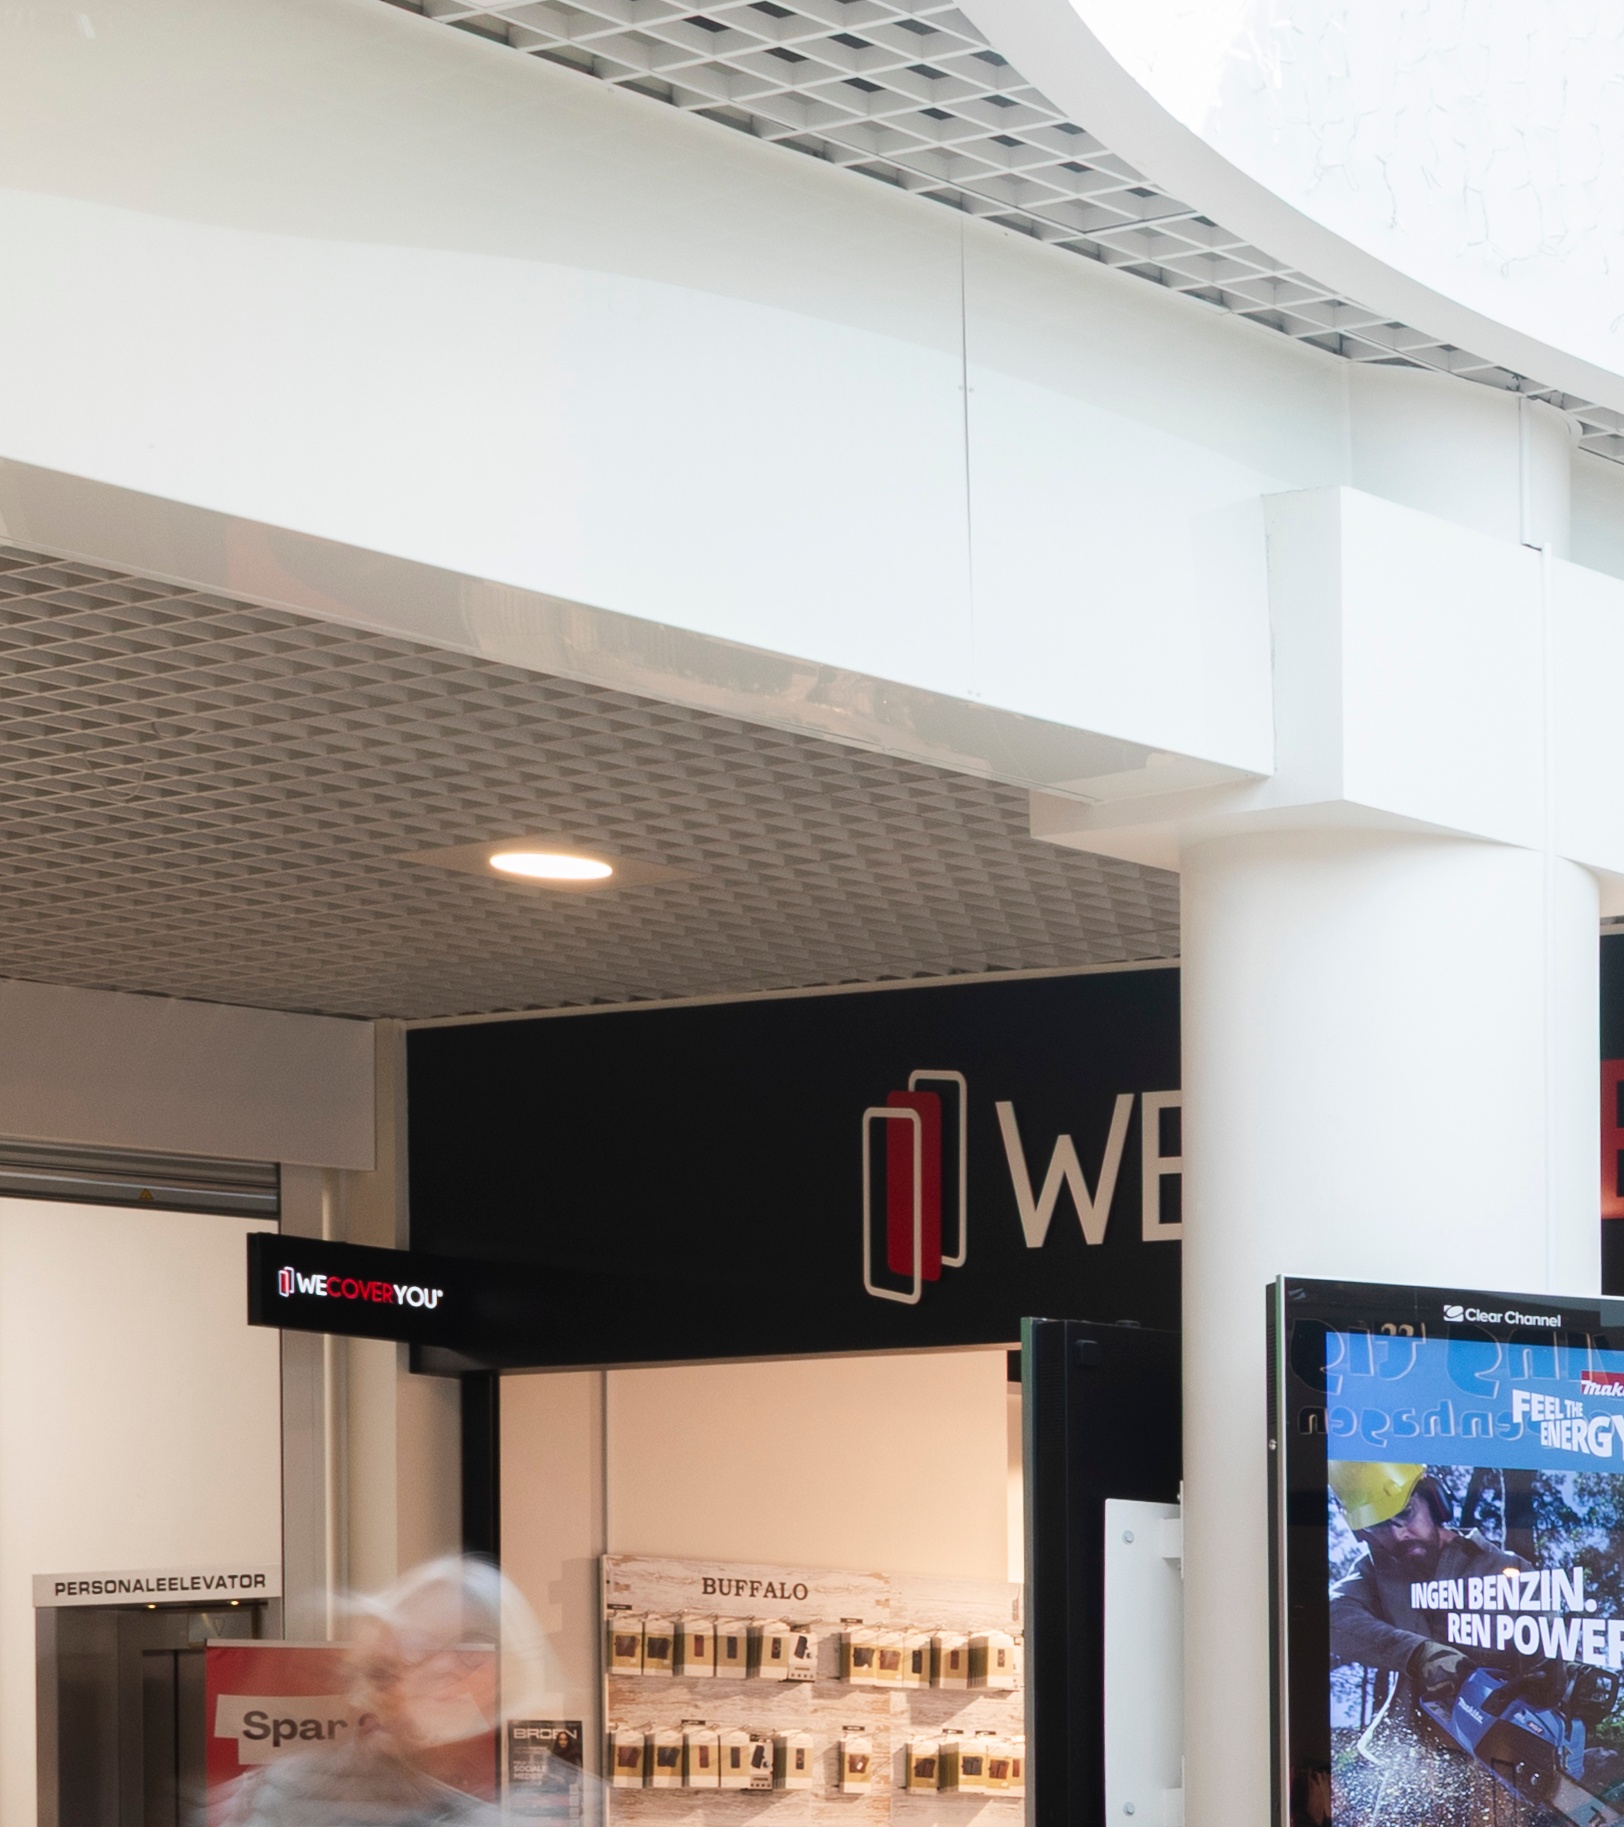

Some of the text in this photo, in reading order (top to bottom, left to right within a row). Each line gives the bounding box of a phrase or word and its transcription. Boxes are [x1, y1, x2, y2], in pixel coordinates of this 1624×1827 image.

[1465, 1308, 1561, 1327] Clear Channel
[1512, 1389, 1583, 1423] FEEL THE
[55, 1574, 266, 1596] PERSONALEELEVATOR
[702, 1577, 808, 1601] BUFFALO
[1411, 1566, 1597, 1613] INGEN BENZIN.
[1448, 1612, 1491, 1648] REN
[242, 1711, 347, 1747] Spar
